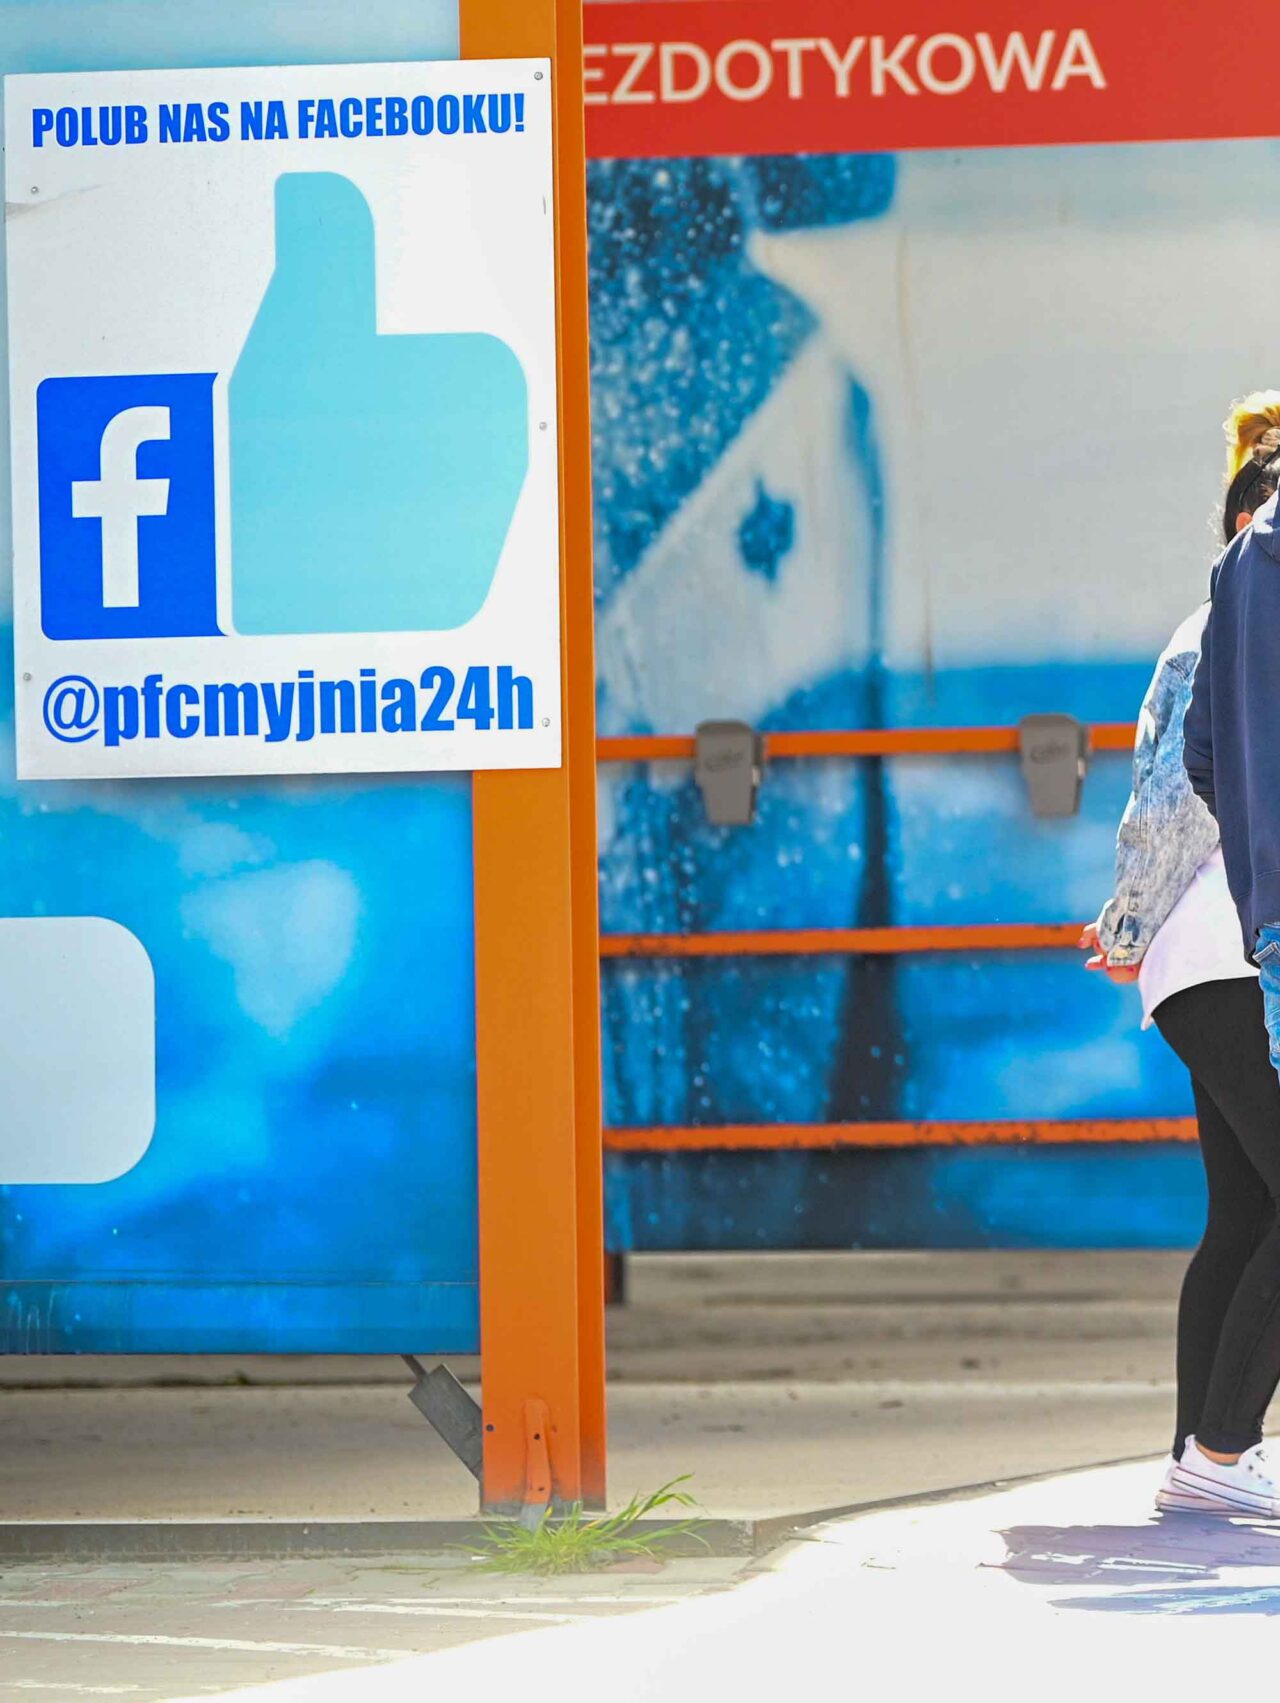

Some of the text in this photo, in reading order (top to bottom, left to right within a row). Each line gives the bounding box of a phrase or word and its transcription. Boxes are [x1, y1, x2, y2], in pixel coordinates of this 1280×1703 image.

[32, 93, 525, 148] POLUB NAS NA FACEBOOKU!
[43, 666, 534, 748] @pfcmyjnia24h
